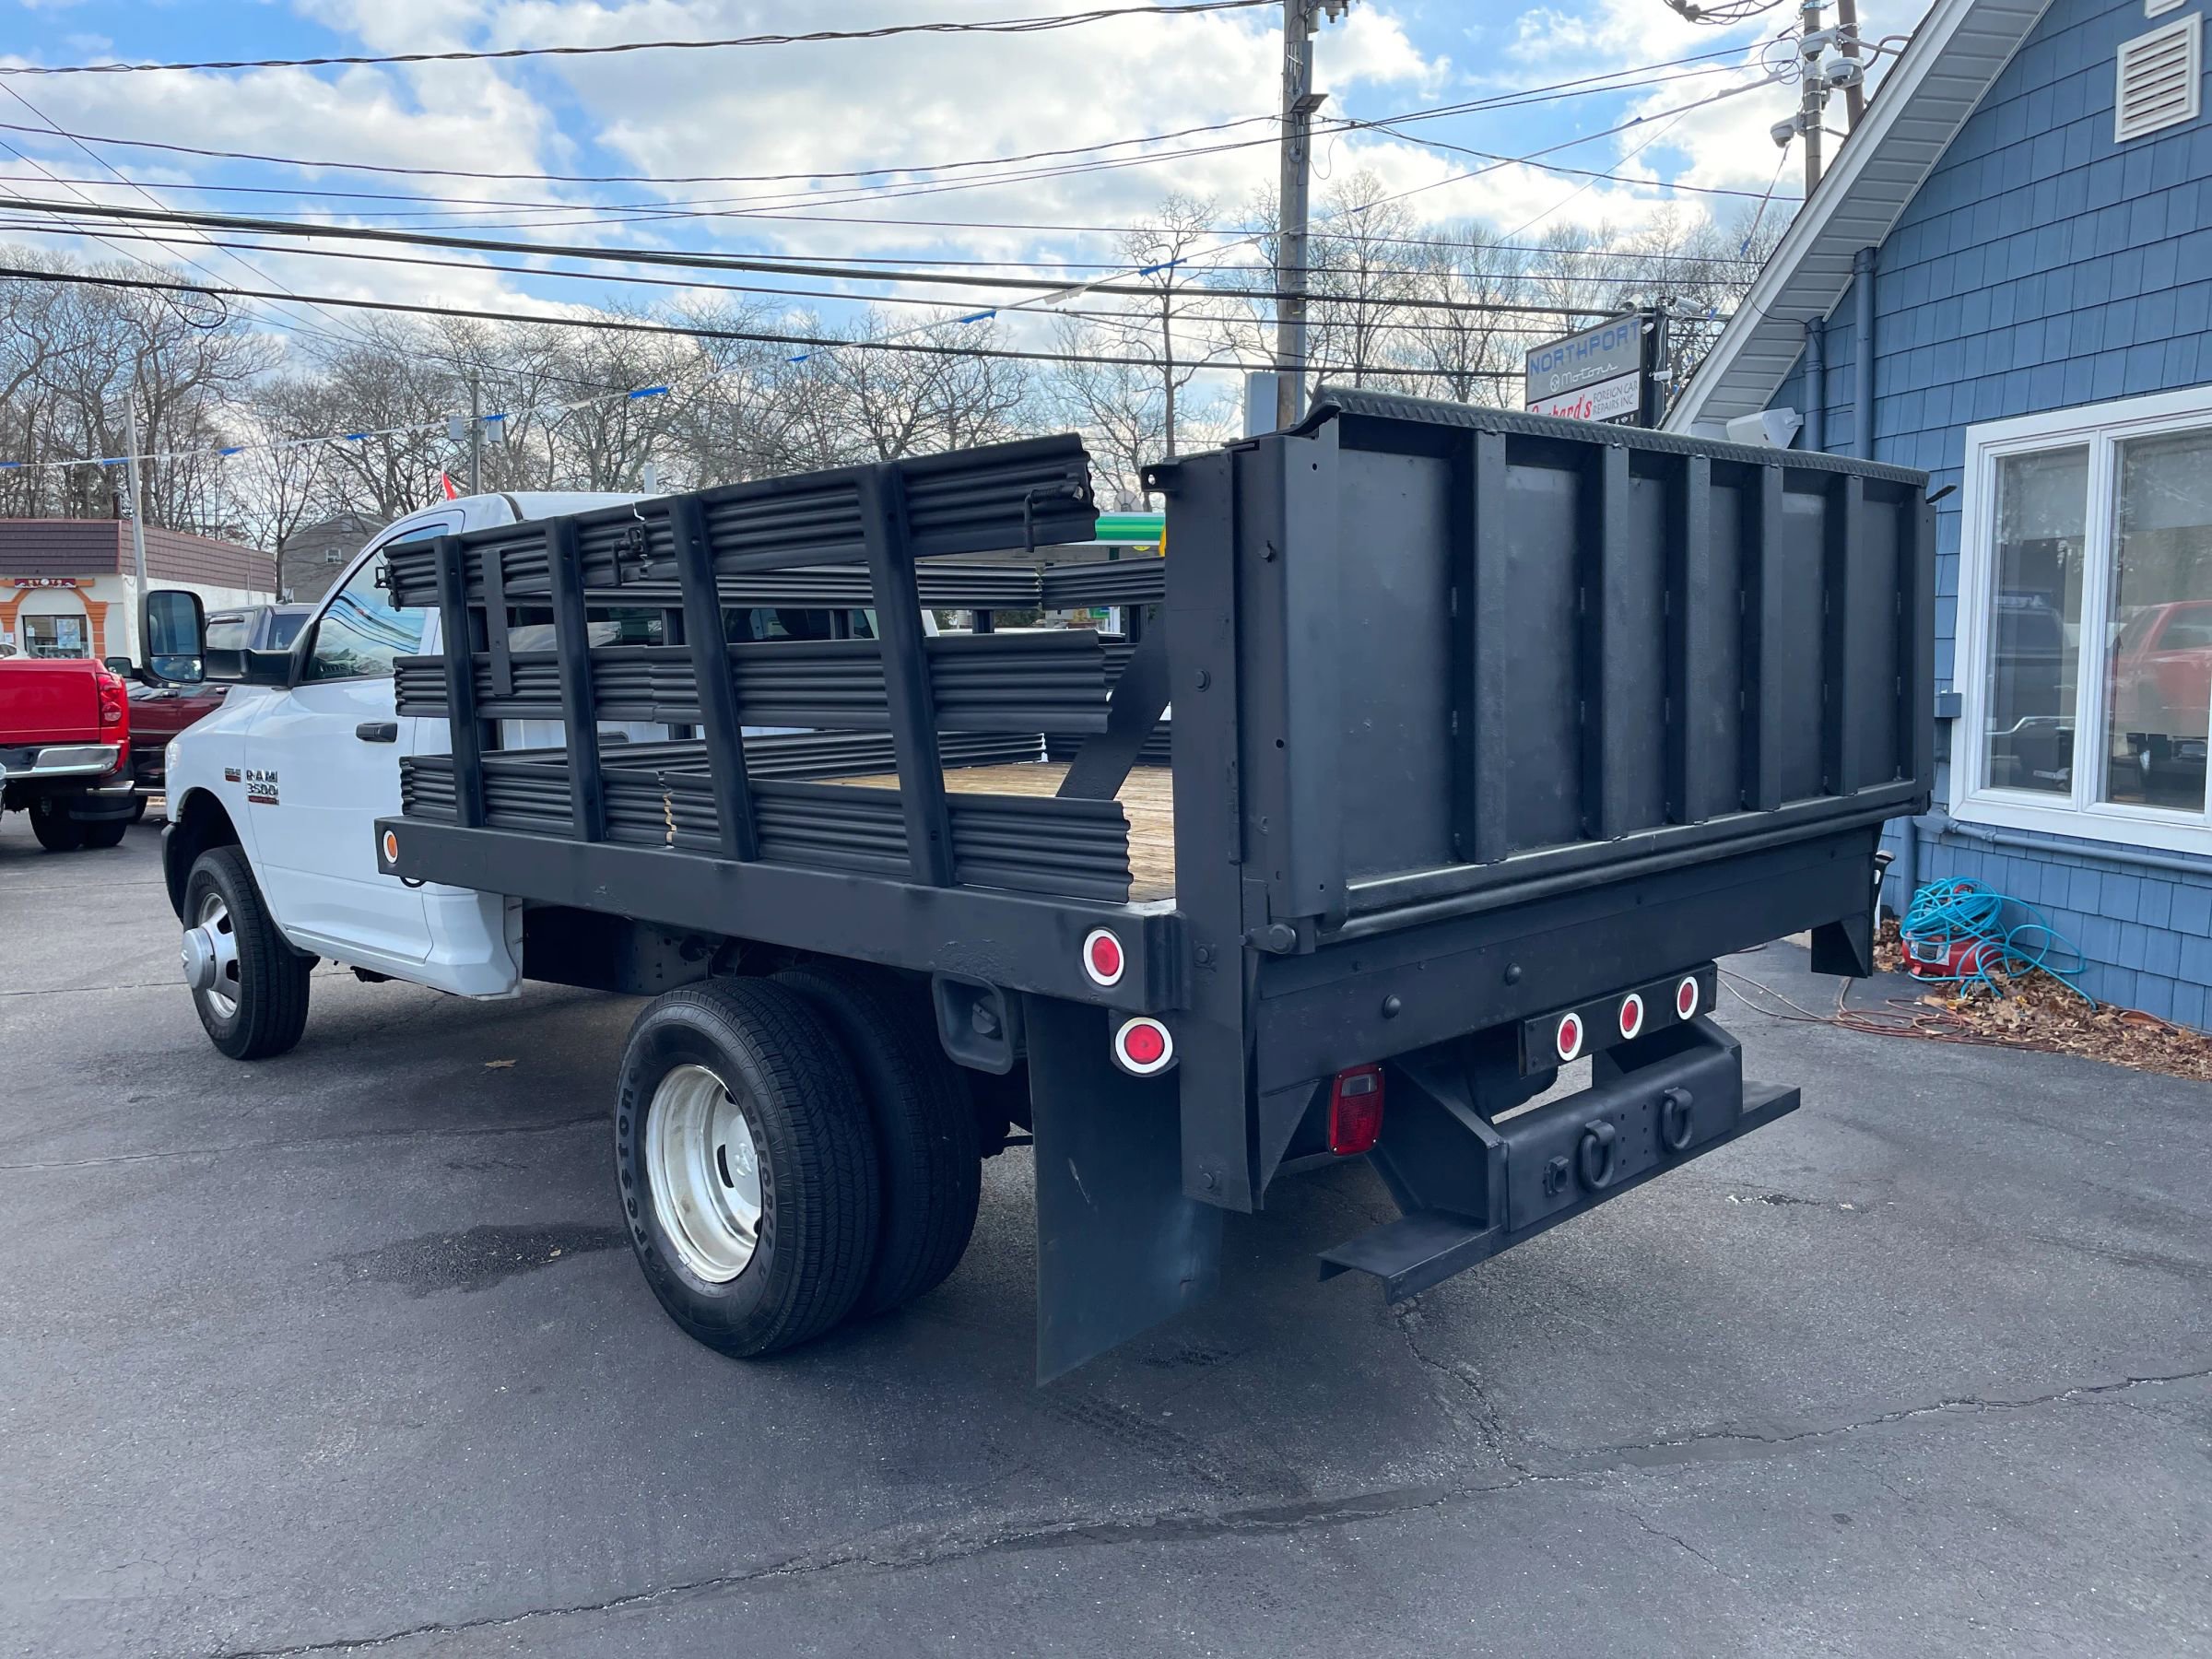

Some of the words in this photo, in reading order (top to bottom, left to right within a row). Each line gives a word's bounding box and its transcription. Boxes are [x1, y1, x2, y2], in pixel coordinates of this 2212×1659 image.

[1530, 321, 1640, 376] NORTHPORT
[1562, 363, 1618, 386] Motors
[1593, 385, 1622, 403] FOREIGN
[1624, 380, 1638, 394] CAR
[1531, 394, 1593, 420] hard's
[1593, 398, 1619, 416] REPAIRS
[1621, 394, 1634, 407] INC
[246, 770, 278, 783] RAM
[246, 782, 278, 796] 3500
